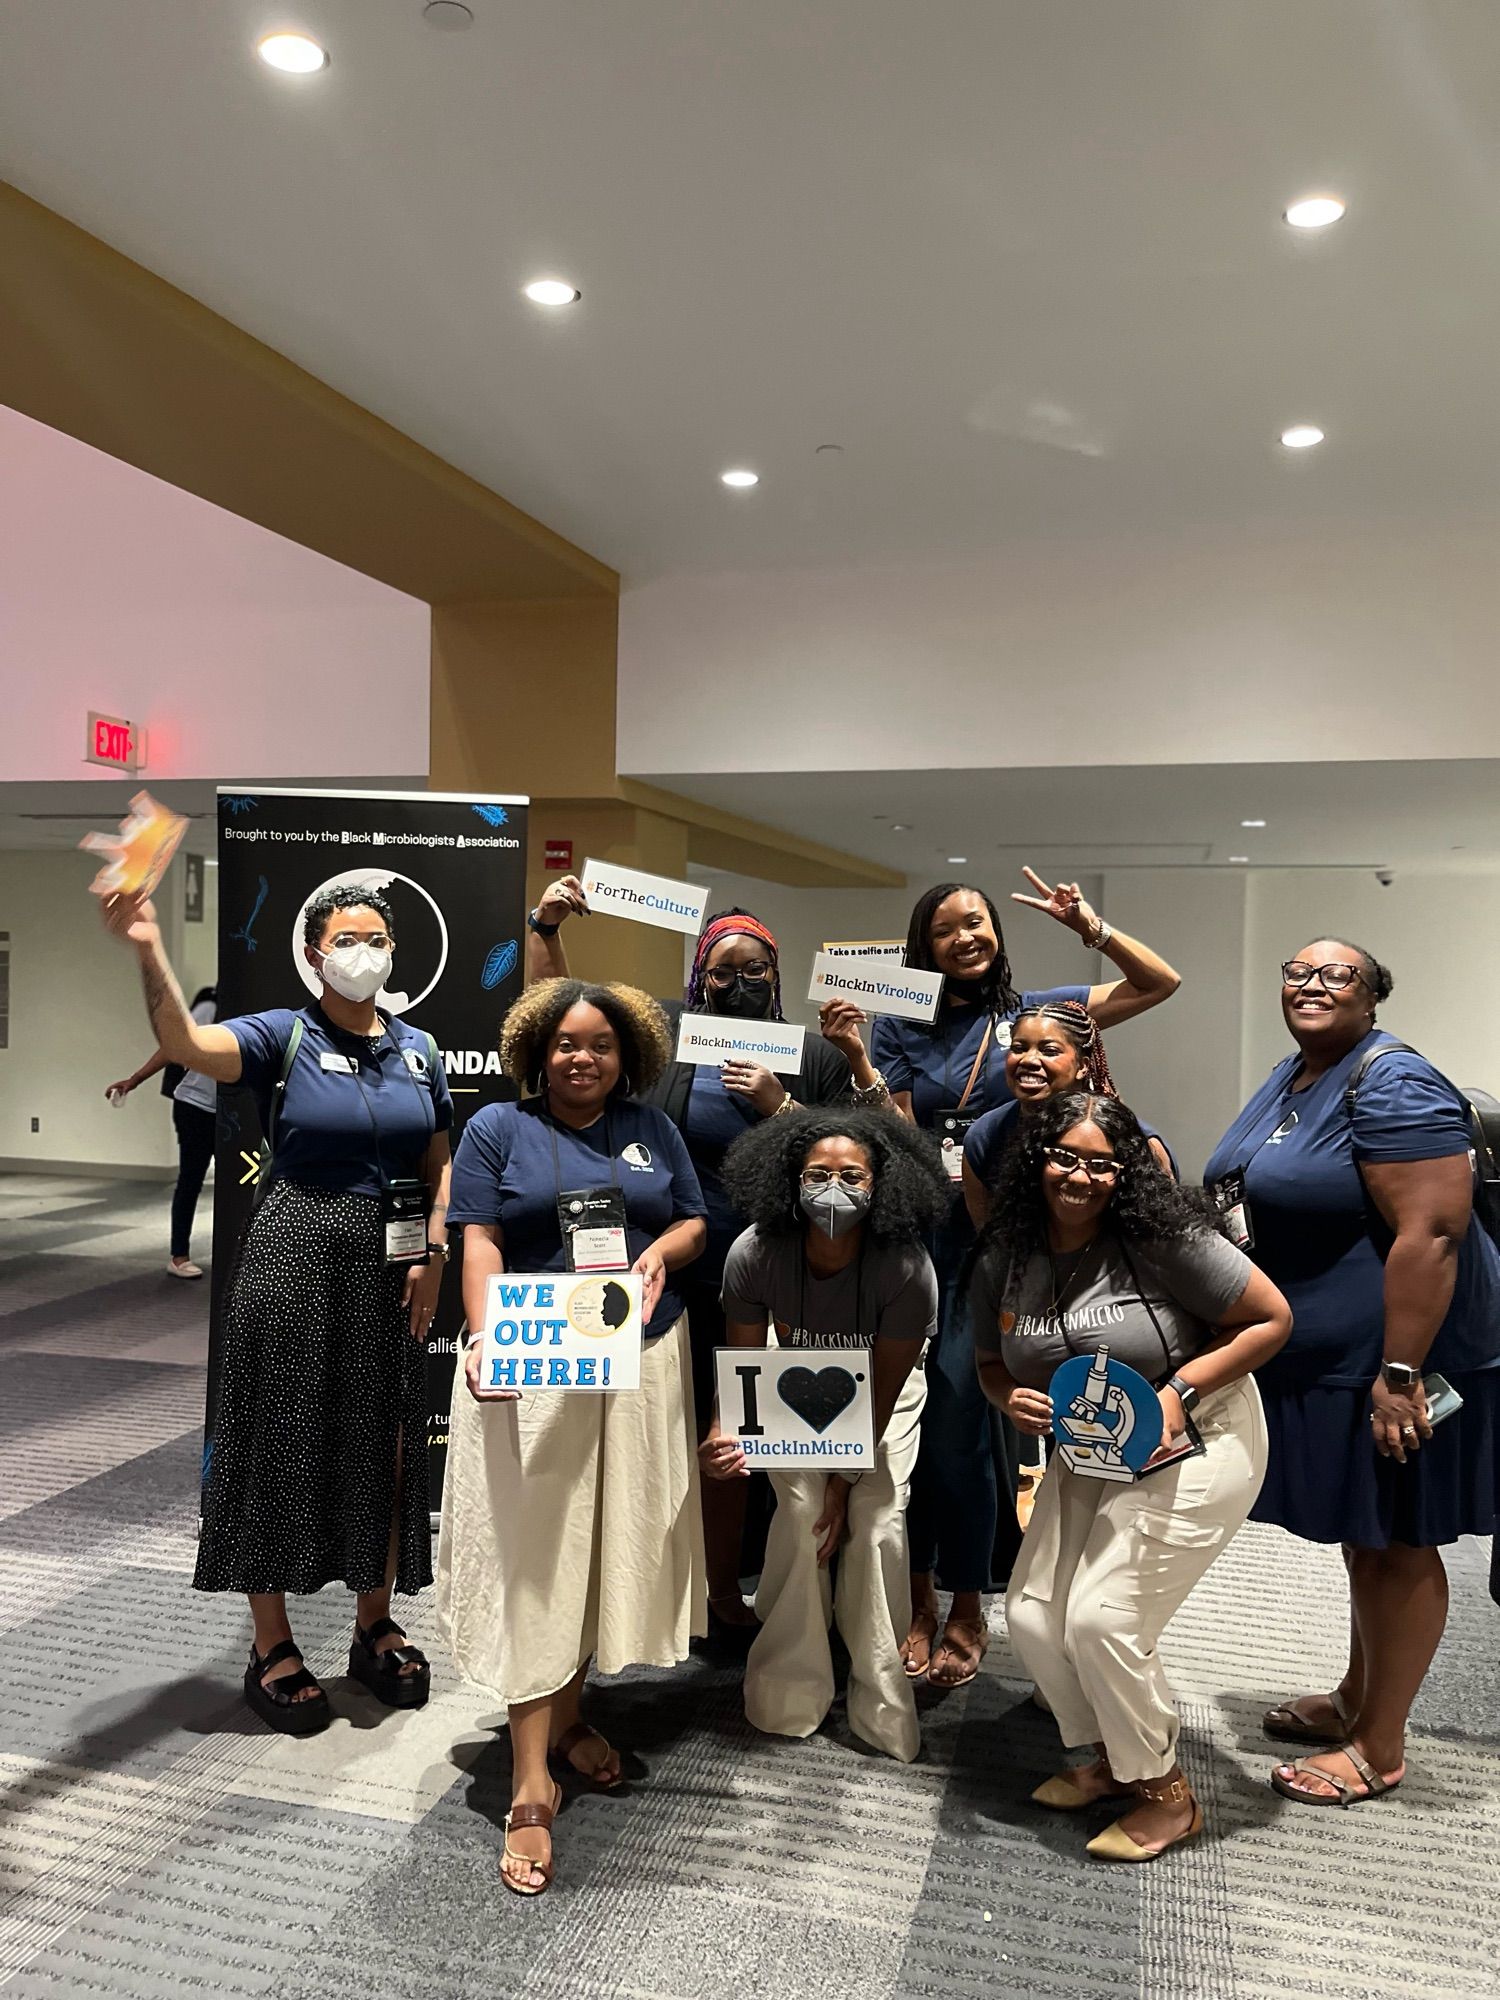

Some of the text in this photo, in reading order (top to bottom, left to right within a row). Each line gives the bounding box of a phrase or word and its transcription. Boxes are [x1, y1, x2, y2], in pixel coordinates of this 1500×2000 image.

[96, 720, 130, 762] EXIT
[225, 827, 520, 848] Brought to you by the Black Microbiologists Association
[586, 881, 699, 918] #ForTheCulture
[828, 948, 849, 956] Take
[858, 947, 882, 956] selfie
[883, 946, 900, 955] and
[817, 974, 933, 1006] #BlackInVirology
[439, 1050, 503, 1075] NDA
[498, 1284, 555, 1308] WE
[494, 1319, 568, 1346] OUT
[1015, 1304, 1125, 1337] #BLACKINMICRO
[490, 1357, 611, 1386] HERE!
[735, 1366, 765, 1436] I
